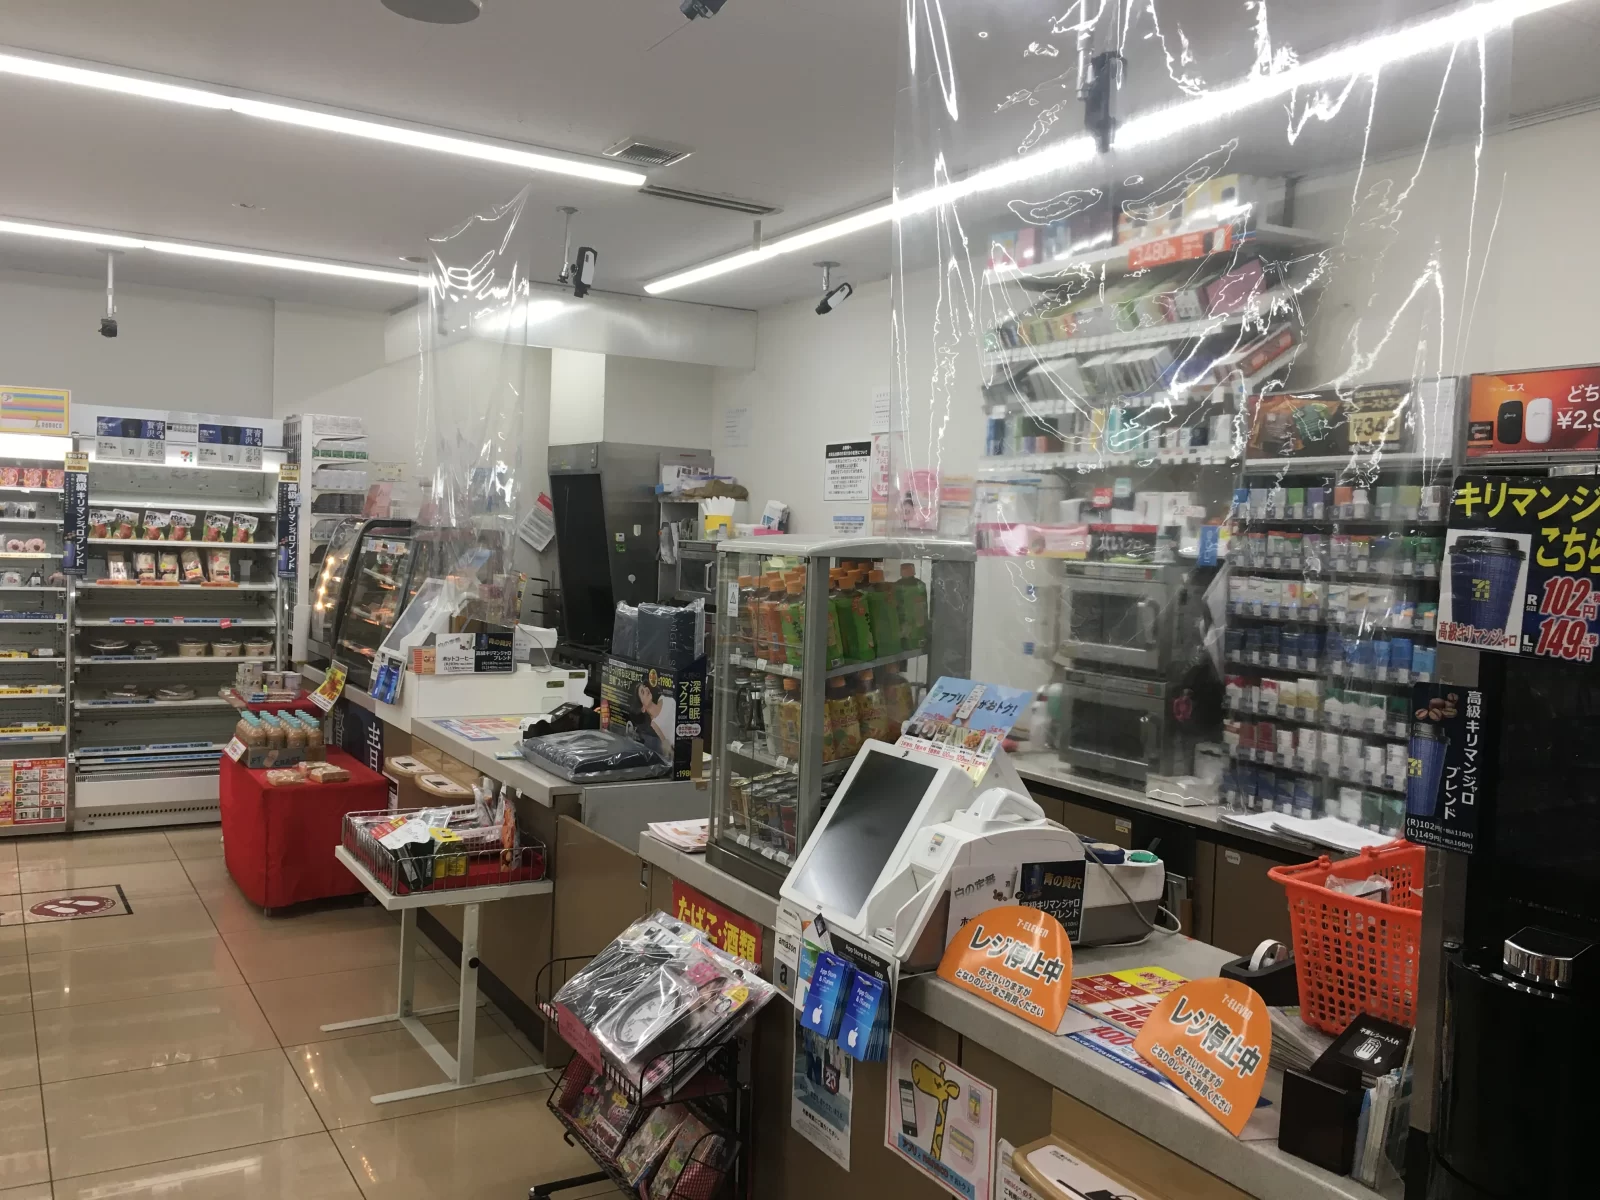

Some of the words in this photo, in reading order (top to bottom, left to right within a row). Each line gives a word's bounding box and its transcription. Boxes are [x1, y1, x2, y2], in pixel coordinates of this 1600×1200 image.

[75, 474, 87, 567] 高級キリマンジャロブレンド
[1527, 594, 1538, 606] R
[1438, 620, 1518, 649] 高級キリマンジャロ
[1523, 634, 1534, 646] L
[678, 681, 690, 714] マクラ
[689, 680, 702, 720] 深睡眠
[938, 692, 965, 706] アプリ
[1461, 690, 1482, 805] 高級キリマンジャロ
[1444, 766, 1462, 820] ブレンド
[778, 937, 797, 955] amazon
[968, 924, 1065, 986] レジ停止中
[955, 968, 1045, 1018] となりのレジをご利用ください
[978, 967, 1032, 997] おそれいりますが
[1168, 995, 1263, 1078] レジ停止中
[1151, 1042, 1233, 1117] となりのレジをご利用ください
[1173, 1045, 1225, 1090] おそれいりますが
